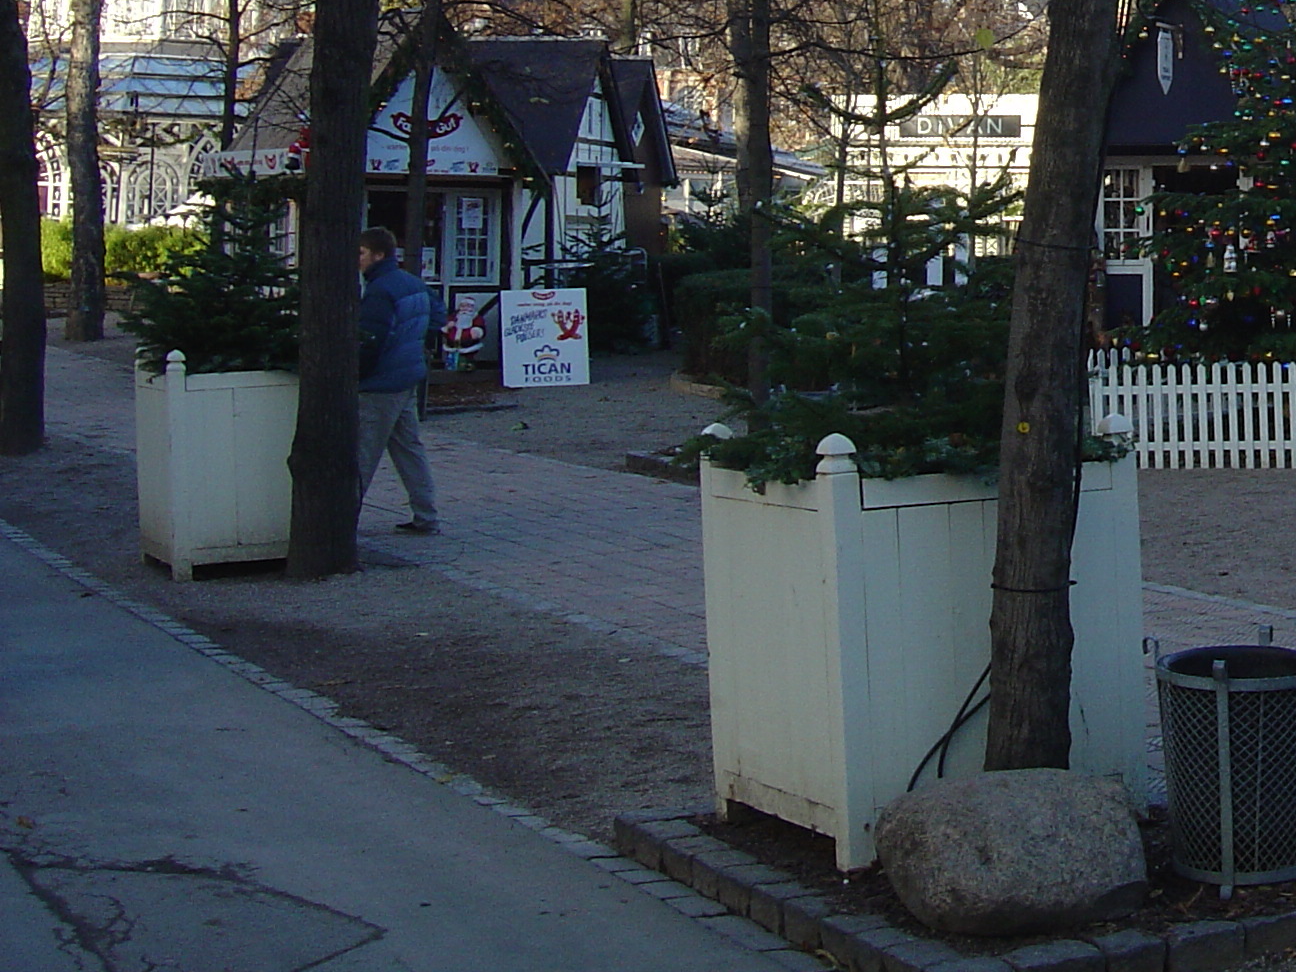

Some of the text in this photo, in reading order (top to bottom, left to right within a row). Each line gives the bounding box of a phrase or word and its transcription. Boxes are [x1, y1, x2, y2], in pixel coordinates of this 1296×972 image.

[435, 117, 457, 134] Gut
[917, 117, 1002, 135] DIVAN
[522, 362, 571, 375] TICAN
[524, 375, 572, 383] FOODS
